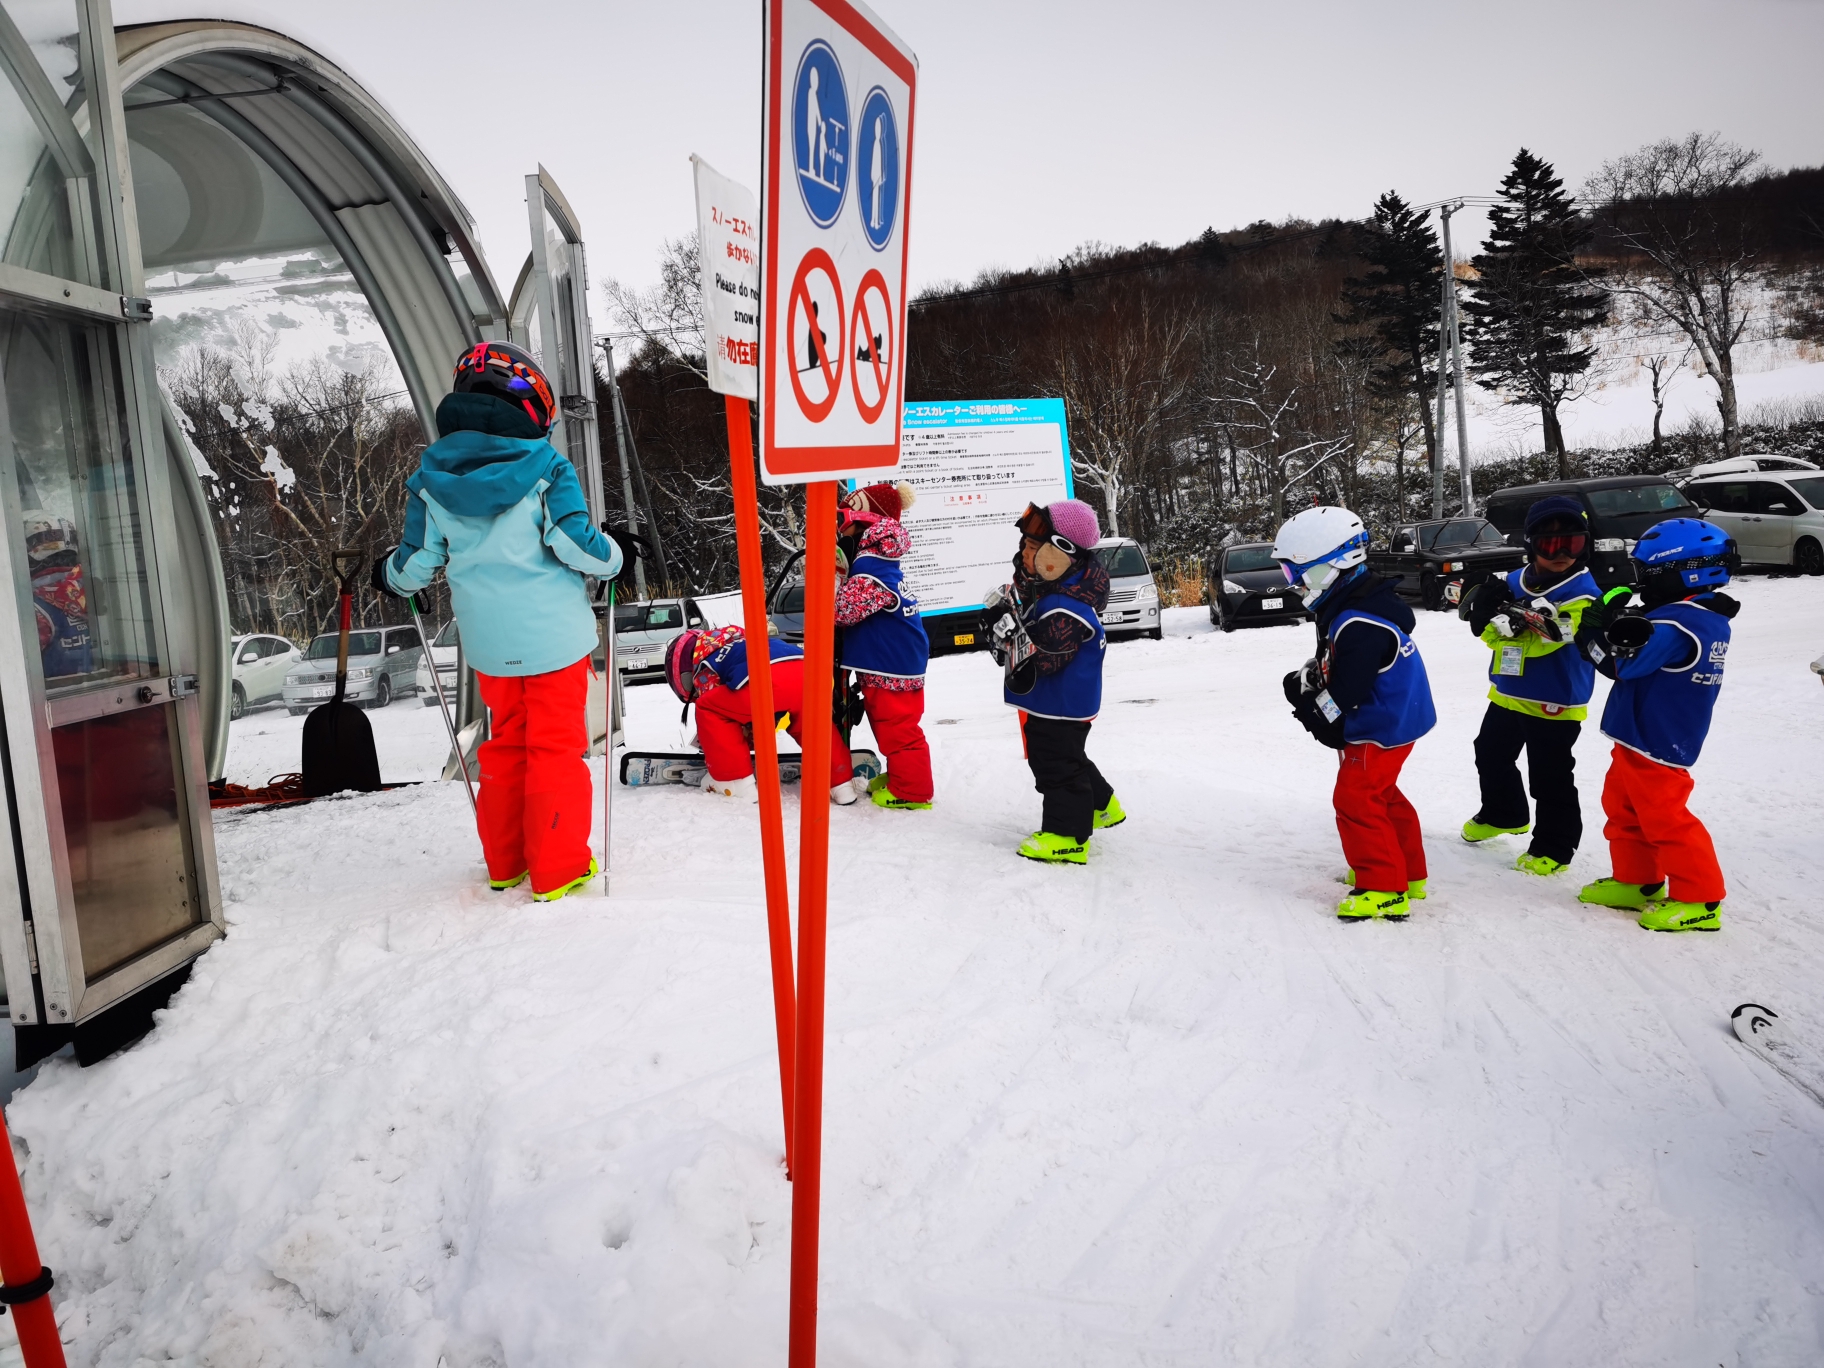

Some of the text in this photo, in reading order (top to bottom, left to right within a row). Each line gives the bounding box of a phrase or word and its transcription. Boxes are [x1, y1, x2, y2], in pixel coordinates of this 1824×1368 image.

[715, 272, 759, 301] Please do no
[734, 309, 754, 326] snow
[1052, 847, 1084, 855] HEAD
[1376, 896, 1405, 910] HEAD
[1680, 913, 1716, 926] HEAD
